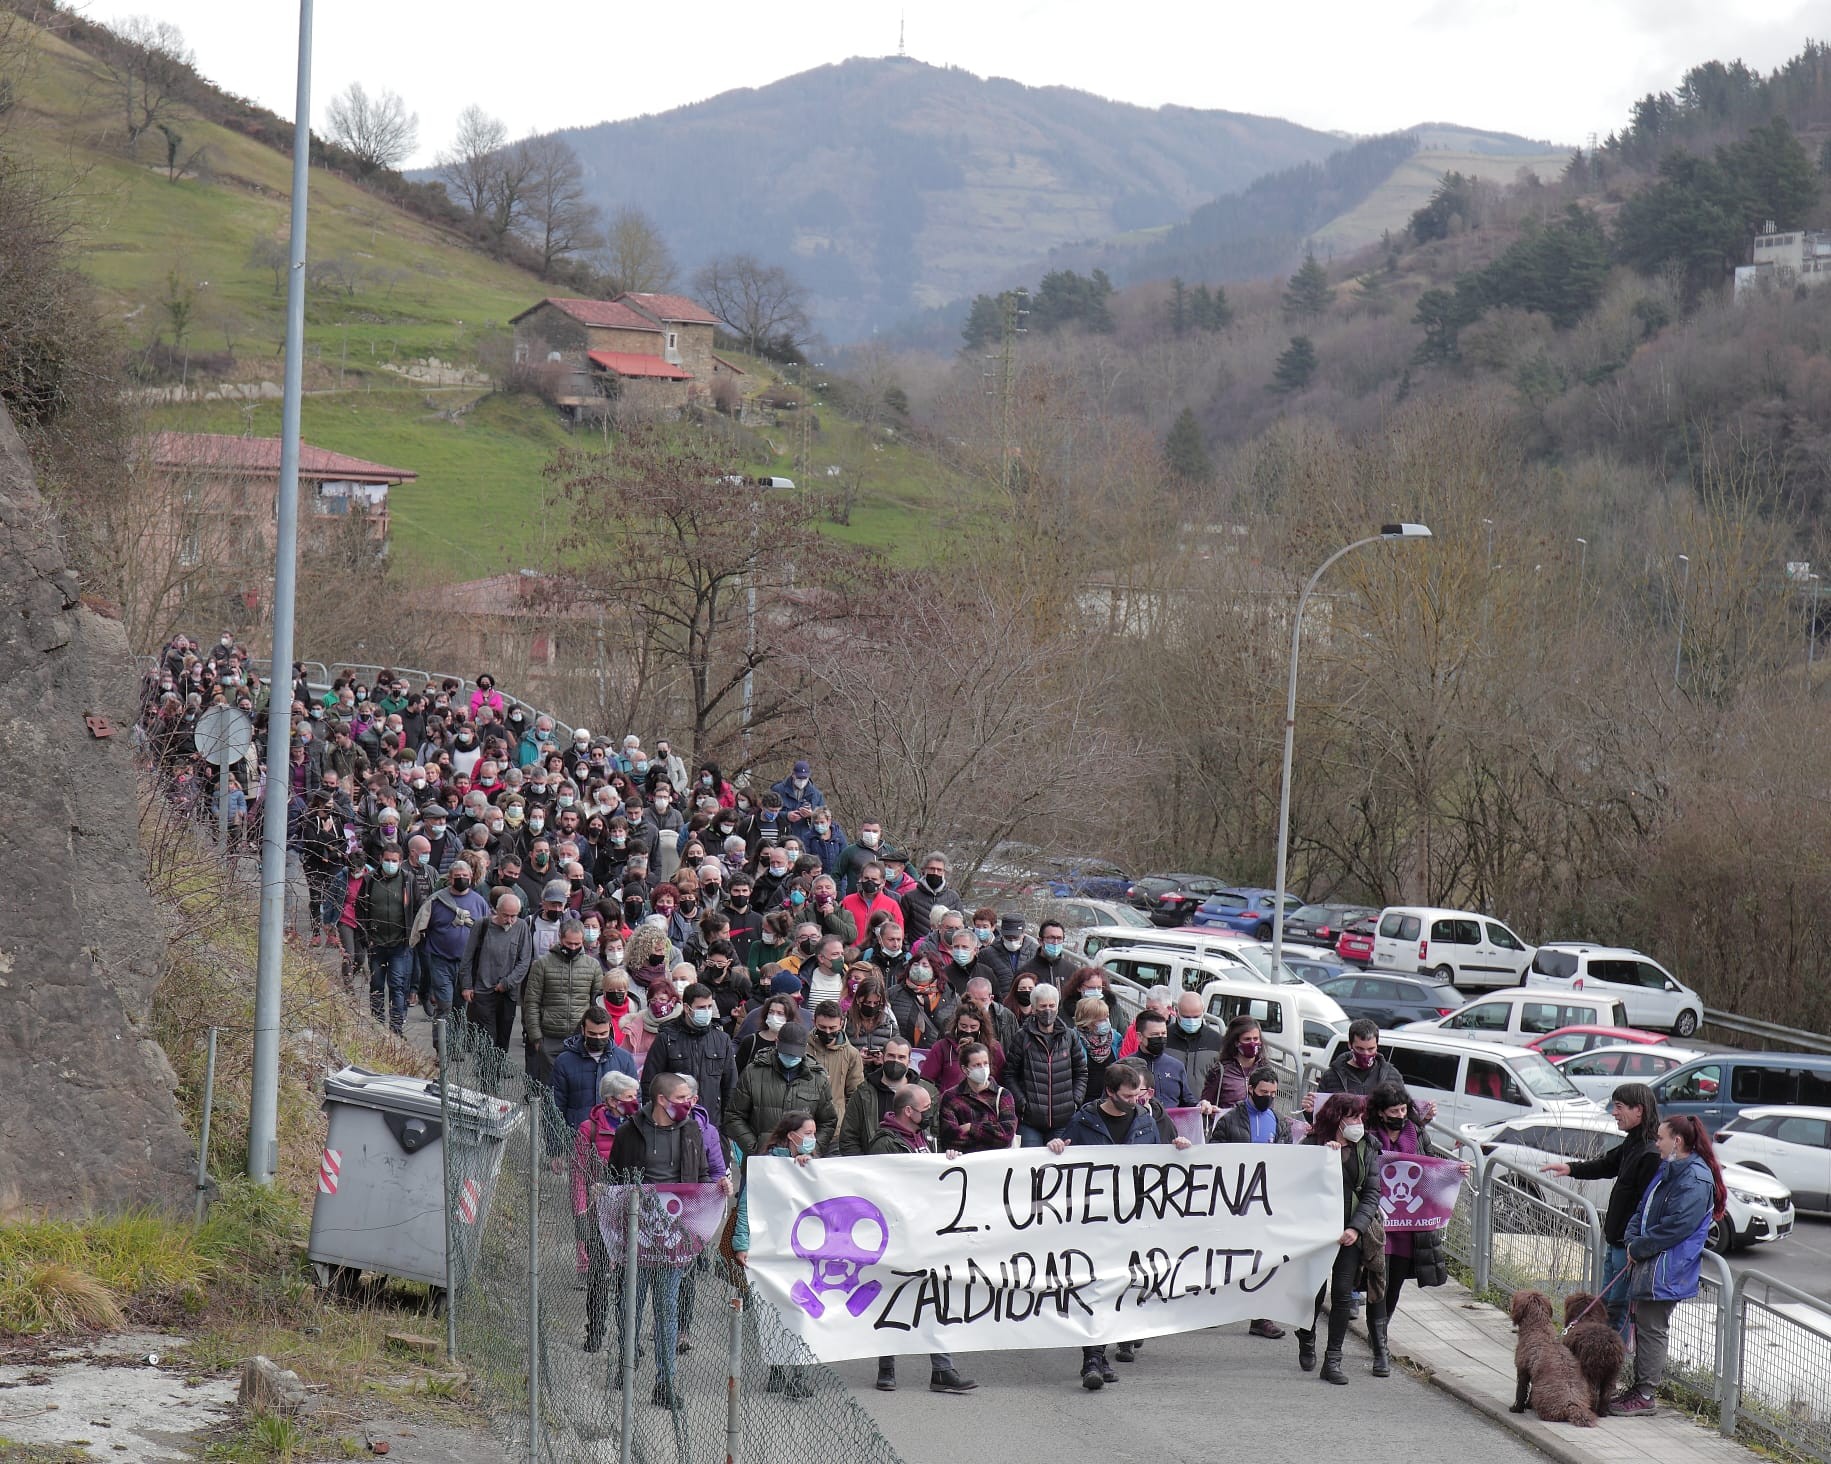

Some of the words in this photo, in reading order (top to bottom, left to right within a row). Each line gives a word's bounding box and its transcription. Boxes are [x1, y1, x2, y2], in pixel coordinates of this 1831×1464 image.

[936, 1166, 991, 1236] 2.
[1003, 1161, 1272, 1231] URTEURRENA
[1384, 1219, 1412, 1227] DIBAR
[873, 1247, 1094, 1331] ZALDIBAR
[1114, 1244, 1292, 1313] ARGITU
